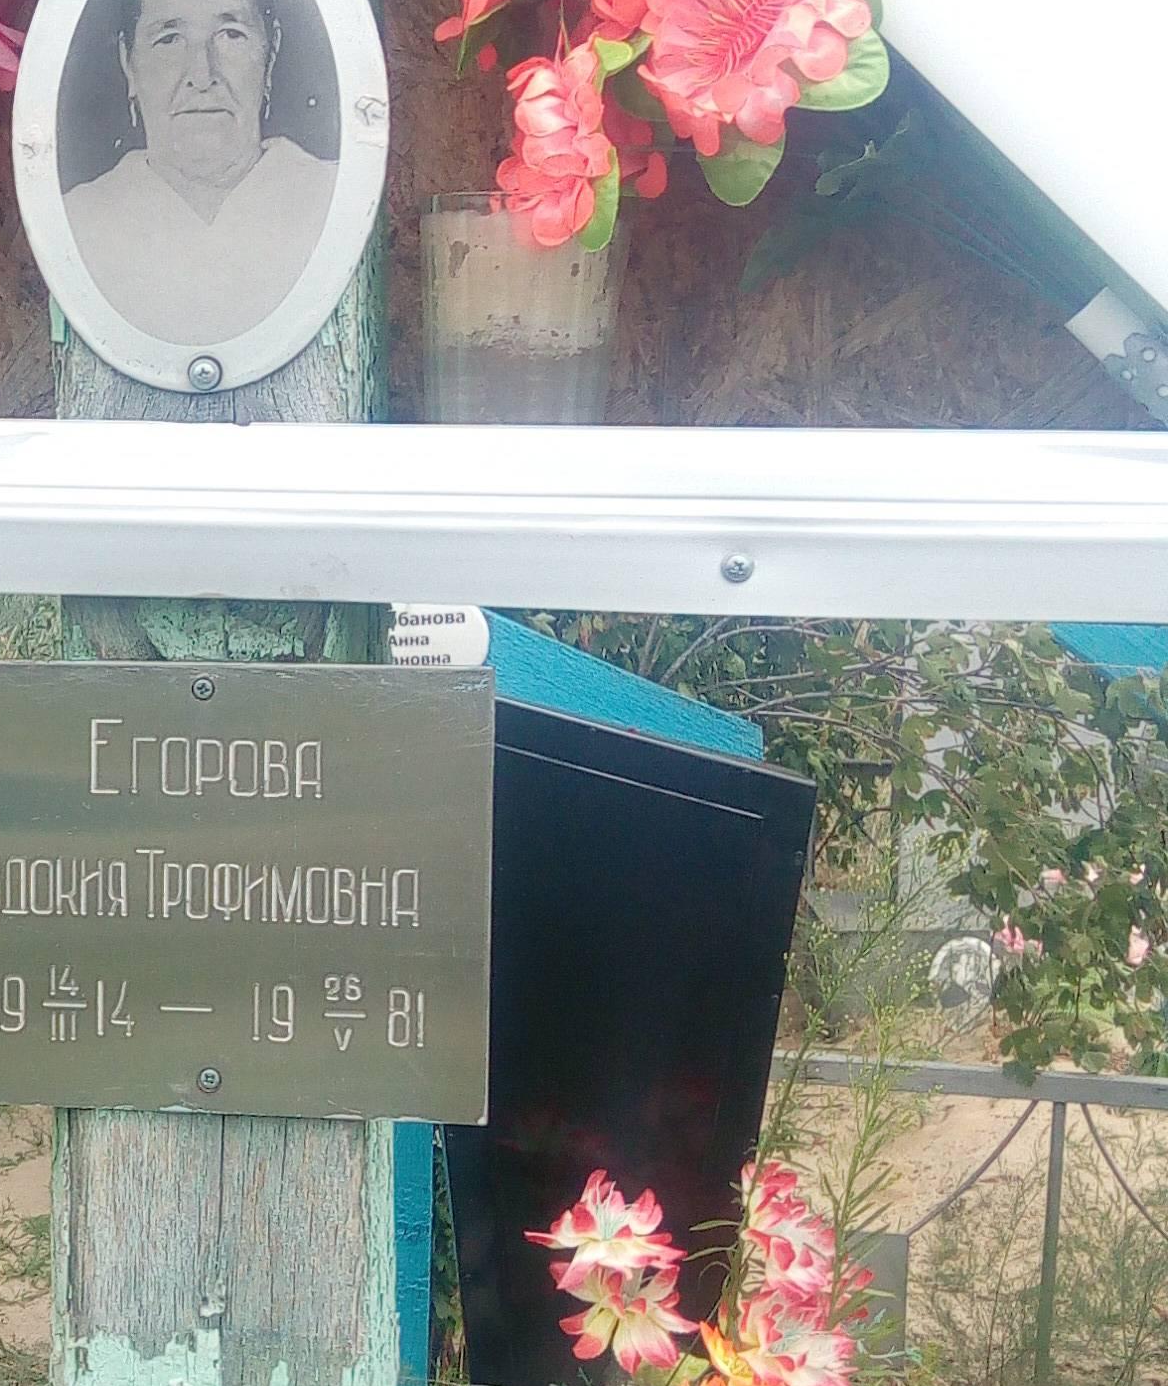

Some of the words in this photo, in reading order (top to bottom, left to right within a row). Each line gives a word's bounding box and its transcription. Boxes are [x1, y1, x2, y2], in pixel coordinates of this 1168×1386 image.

[394, 612, 465, 626] банова
[89, 718, 323, 798] Егорова
[136, 848, 420, 927] Трофимовна
